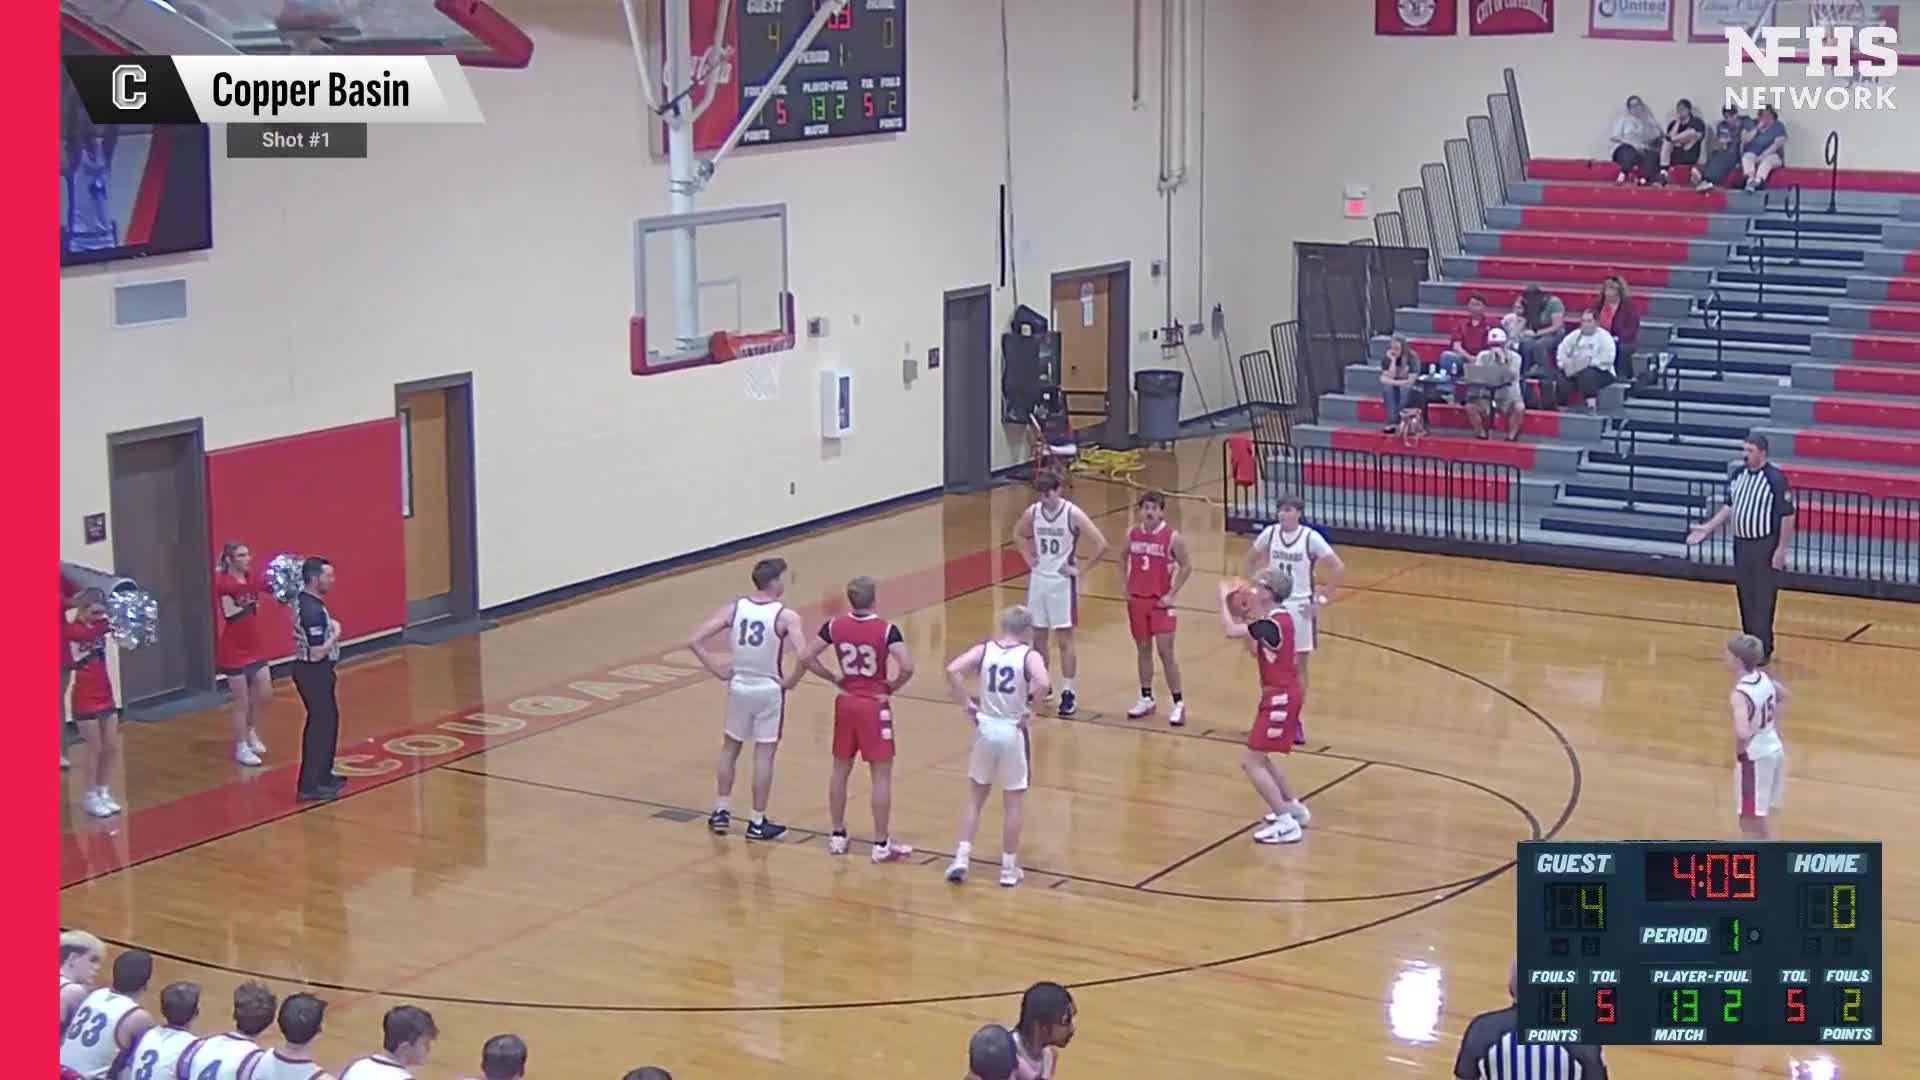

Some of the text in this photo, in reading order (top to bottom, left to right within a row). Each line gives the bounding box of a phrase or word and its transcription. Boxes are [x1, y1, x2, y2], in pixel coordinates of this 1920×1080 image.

[775, 98, 787, 126] 5
[811, 96, 826, 121] 13
[835, 95, 845, 119] 2
[863, 92, 874, 117] 5
[1040, 538, 1059, 555] 50
[1141, 555, 1150, 571] 3
[738, 617, 766, 647] 13
[839, 643, 878, 677] 23
[987, 663, 1016, 695] 12
[67, 1006, 107, 1047] 33
[135, 1049, 159, 1080] 3
